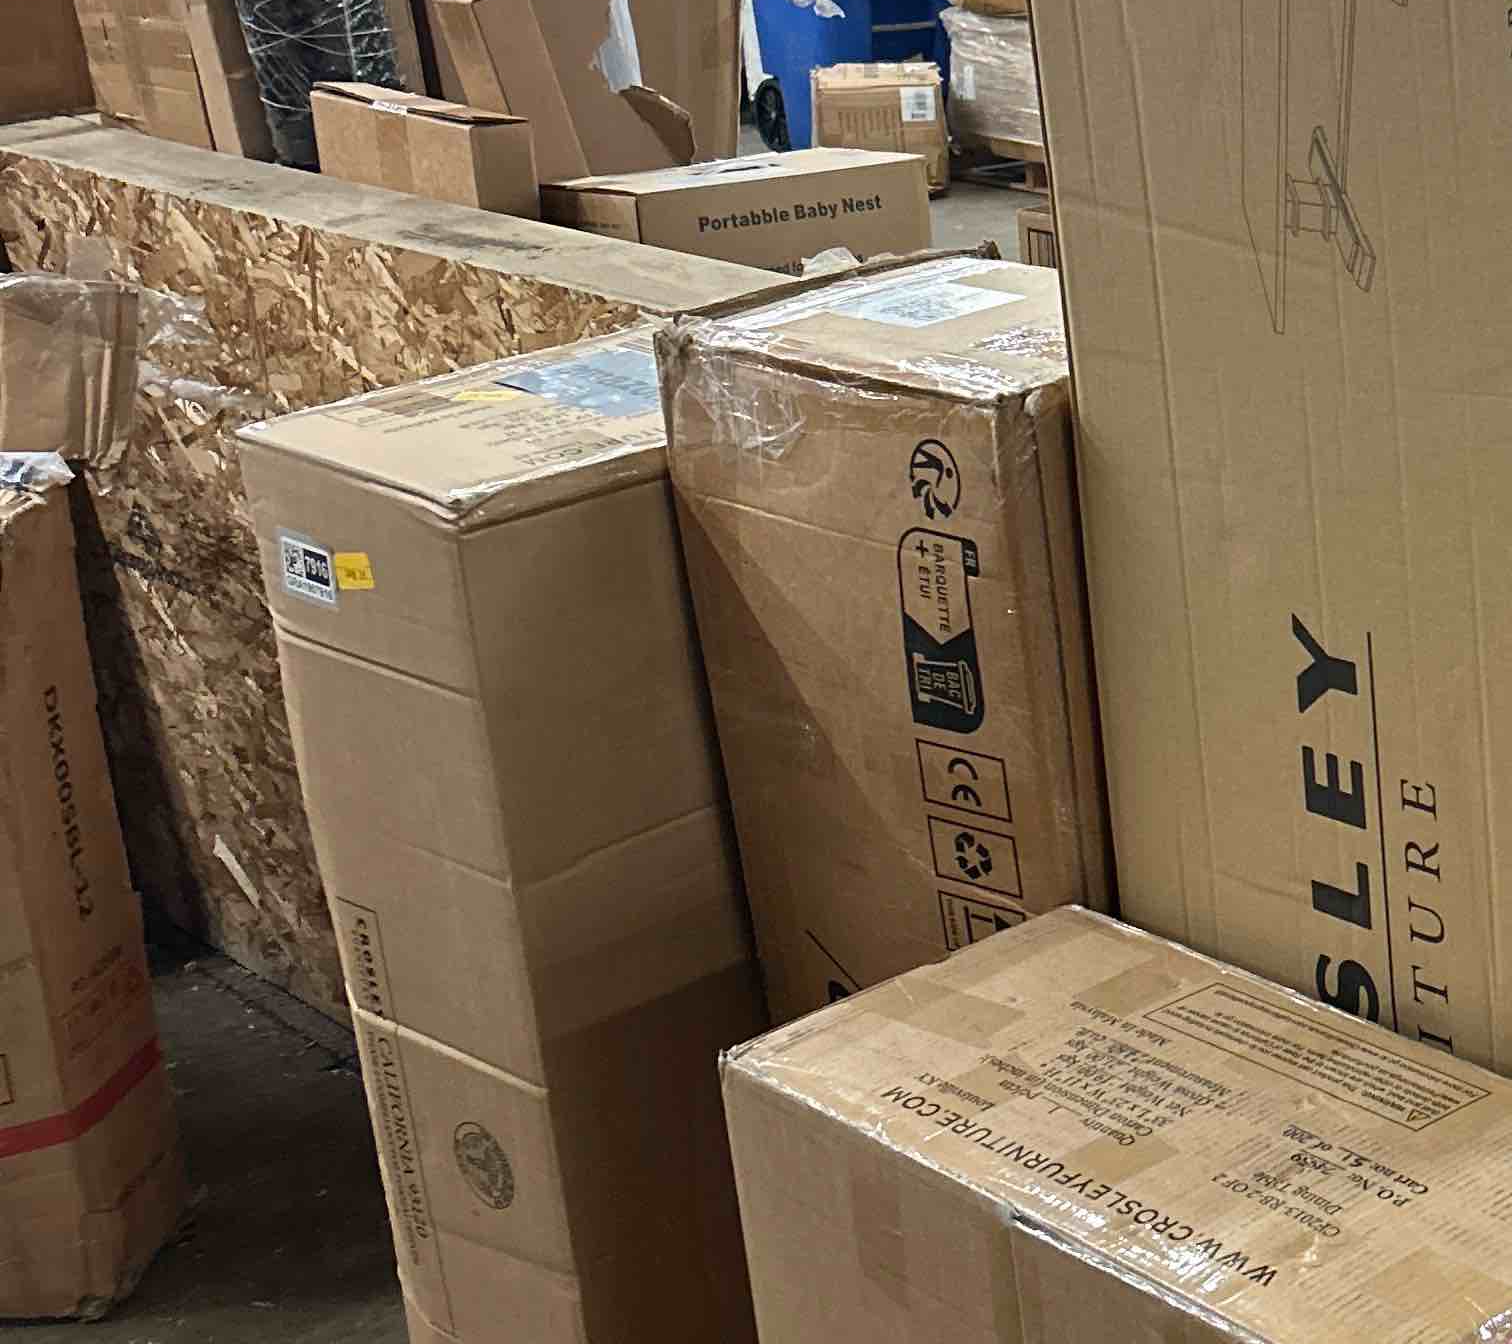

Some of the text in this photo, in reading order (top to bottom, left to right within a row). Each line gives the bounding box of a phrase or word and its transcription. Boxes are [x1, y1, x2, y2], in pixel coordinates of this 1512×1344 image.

[699, 194, 882, 233] Portabble Baby Nest
[304, 555, 329, 579] 7916
[933, 544, 952, 633] BARQUETTE
[918, 669, 931, 690] TRI
[932, 673, 946, 689] DE
[946, 671, 961, 698] BAC
[1292, 614, 1379, 1021] SLEY
[878, 1085, 1283, 1286] WWW.CROSLEYFURNITURE.COM
[1389, 1174, 1432, 1195] Cart
[1285, 1184, 1347, 1216] Dining
